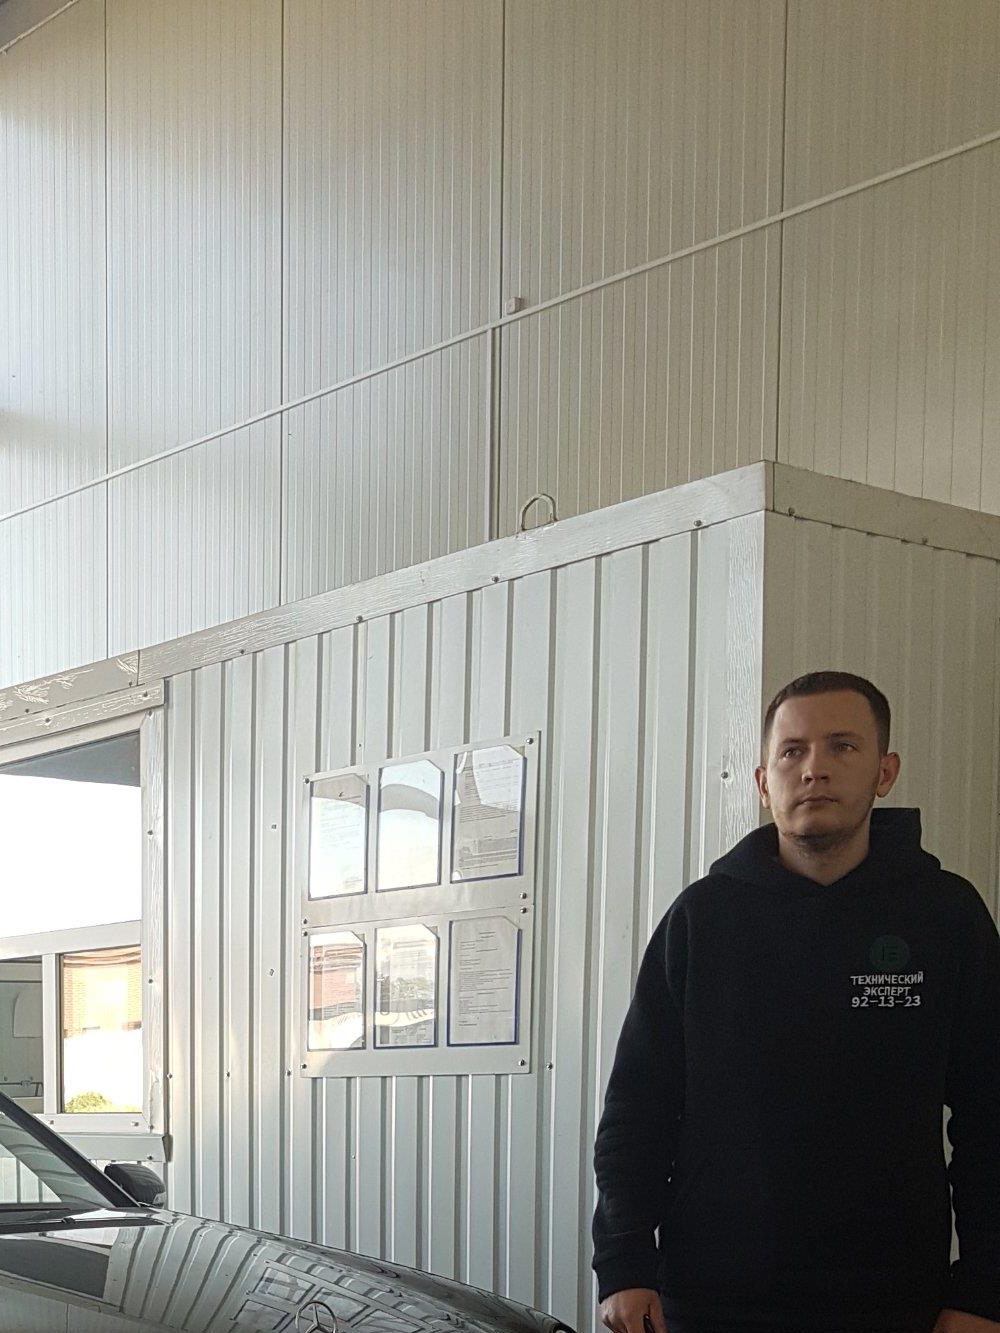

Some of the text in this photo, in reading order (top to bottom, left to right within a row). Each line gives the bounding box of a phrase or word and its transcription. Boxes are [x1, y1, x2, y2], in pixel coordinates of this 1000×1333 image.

[850, 971, 924, 985] ТЕХНИЧЕСКИЙ
[863, 986, 911, 996] ЭКСПЕРТ
[851, 996, 921, 1007] 92-13-23
